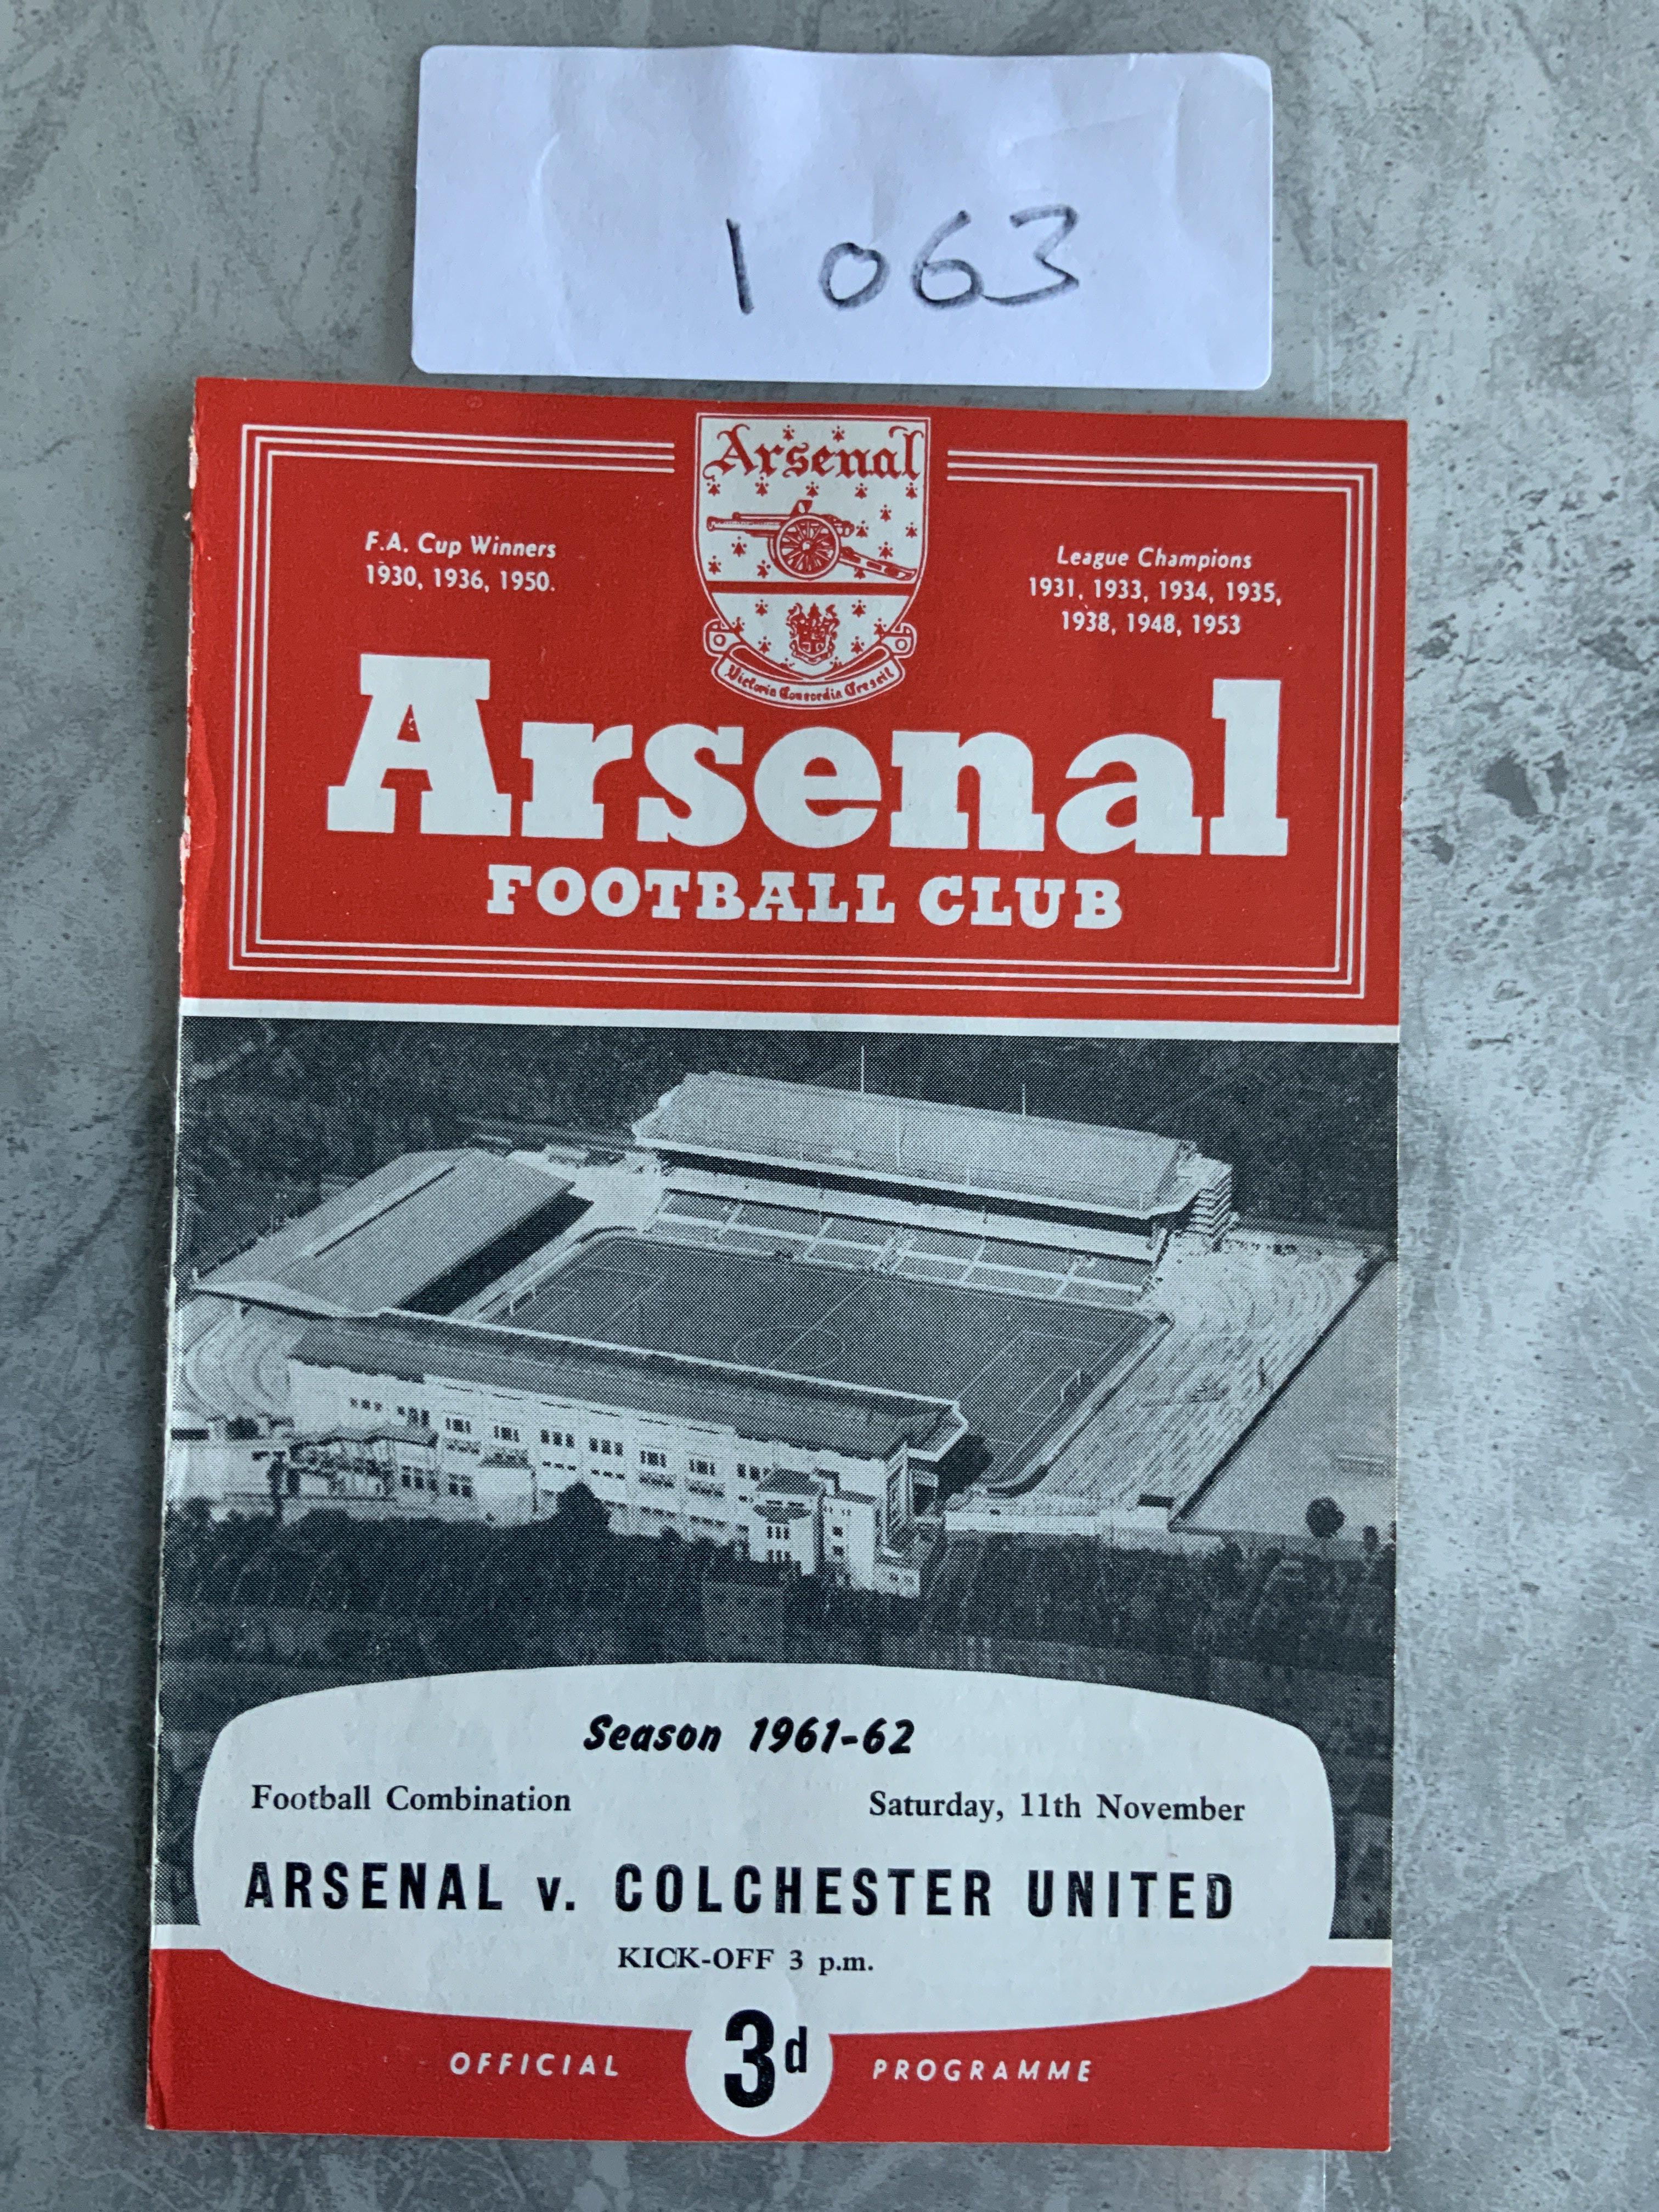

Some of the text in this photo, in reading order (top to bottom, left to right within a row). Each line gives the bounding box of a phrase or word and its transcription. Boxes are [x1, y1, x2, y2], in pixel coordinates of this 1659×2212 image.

[725, 204, 1080, 315] 1063
[702, 423, 925, 481] Arsenal
[365, 531, 556, 559] F.A. Cup Winners
[1057, 545, 1252, 572] League Champions
[366, 564, 555, 593] 1930, 1936, 1950.
[1029, 577, 1282, 606] 1931, 1933, 1934, 1935,
[1062, 610, 1241, 637] 1938, 1948, 1953
[326, 653, 1289, 857] Arsenal
[487, 864, 1123, 930] FOOTBALL CLUB
[583, 1714, 915, 1755] Season 1961-62
[251, 1785, 572, 1812] Football Combination
[870, 1790, 1245, 1824] Saturday, 11th November
[245, 1861, 1232, 1920] ARSENAL v. COLCHESTER UNITED
[618, 1947, 873, 1976] KICK-OFF 3 p.m.
[450, 2052, 619, 2076] OFFICIAL
[873, 2058, 1092, 2083] PROGRAMME
